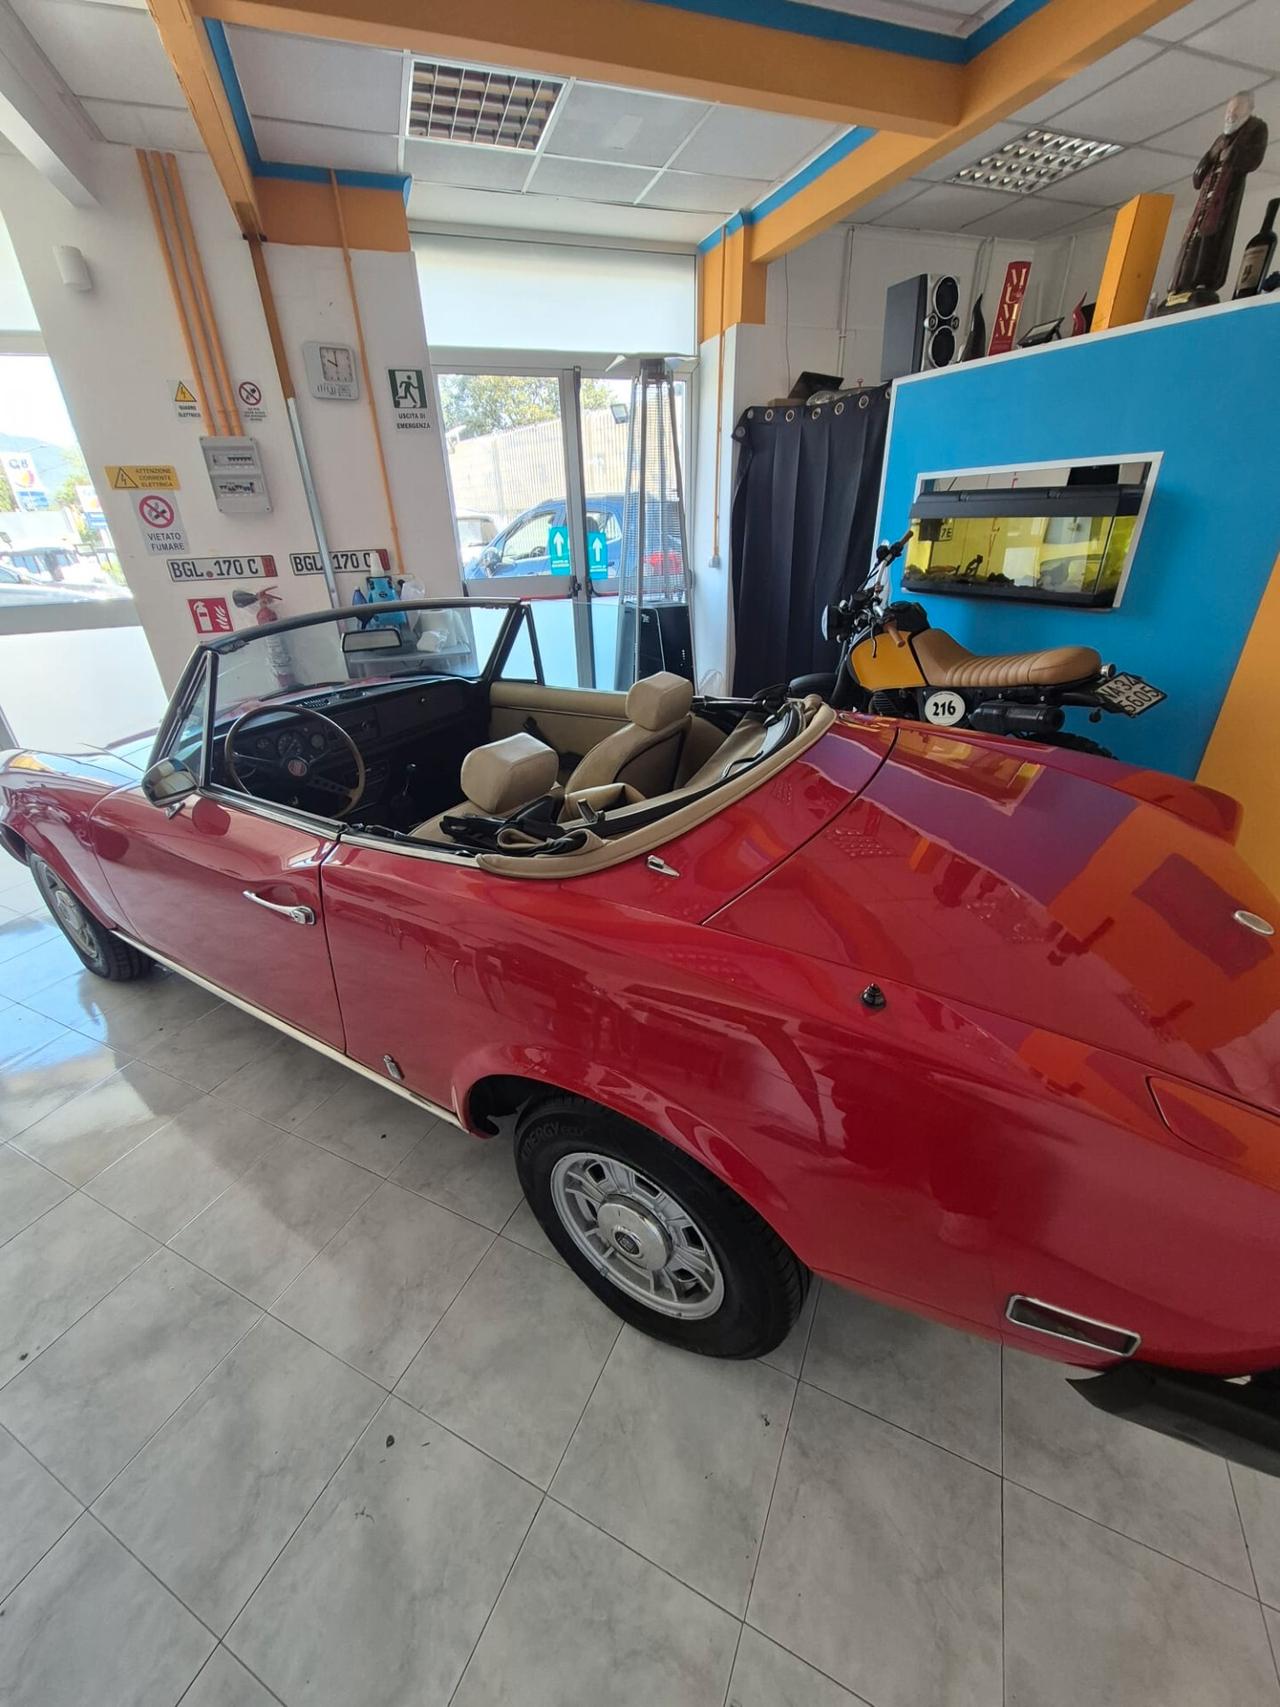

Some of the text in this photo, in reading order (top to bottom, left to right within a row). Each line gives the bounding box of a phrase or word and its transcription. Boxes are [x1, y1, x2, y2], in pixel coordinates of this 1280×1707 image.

[398, 412, 419, 420] USCITA
[147, 532, 182, 541] VIETATO
[151, 542, 185, 552] FUMARE
[170, 558, 259, 578] BGL 170 C
[293, 555, 324, 572] BGL
[332, 553, 360, 570] 170
[932, 700, 956, 716] 216
